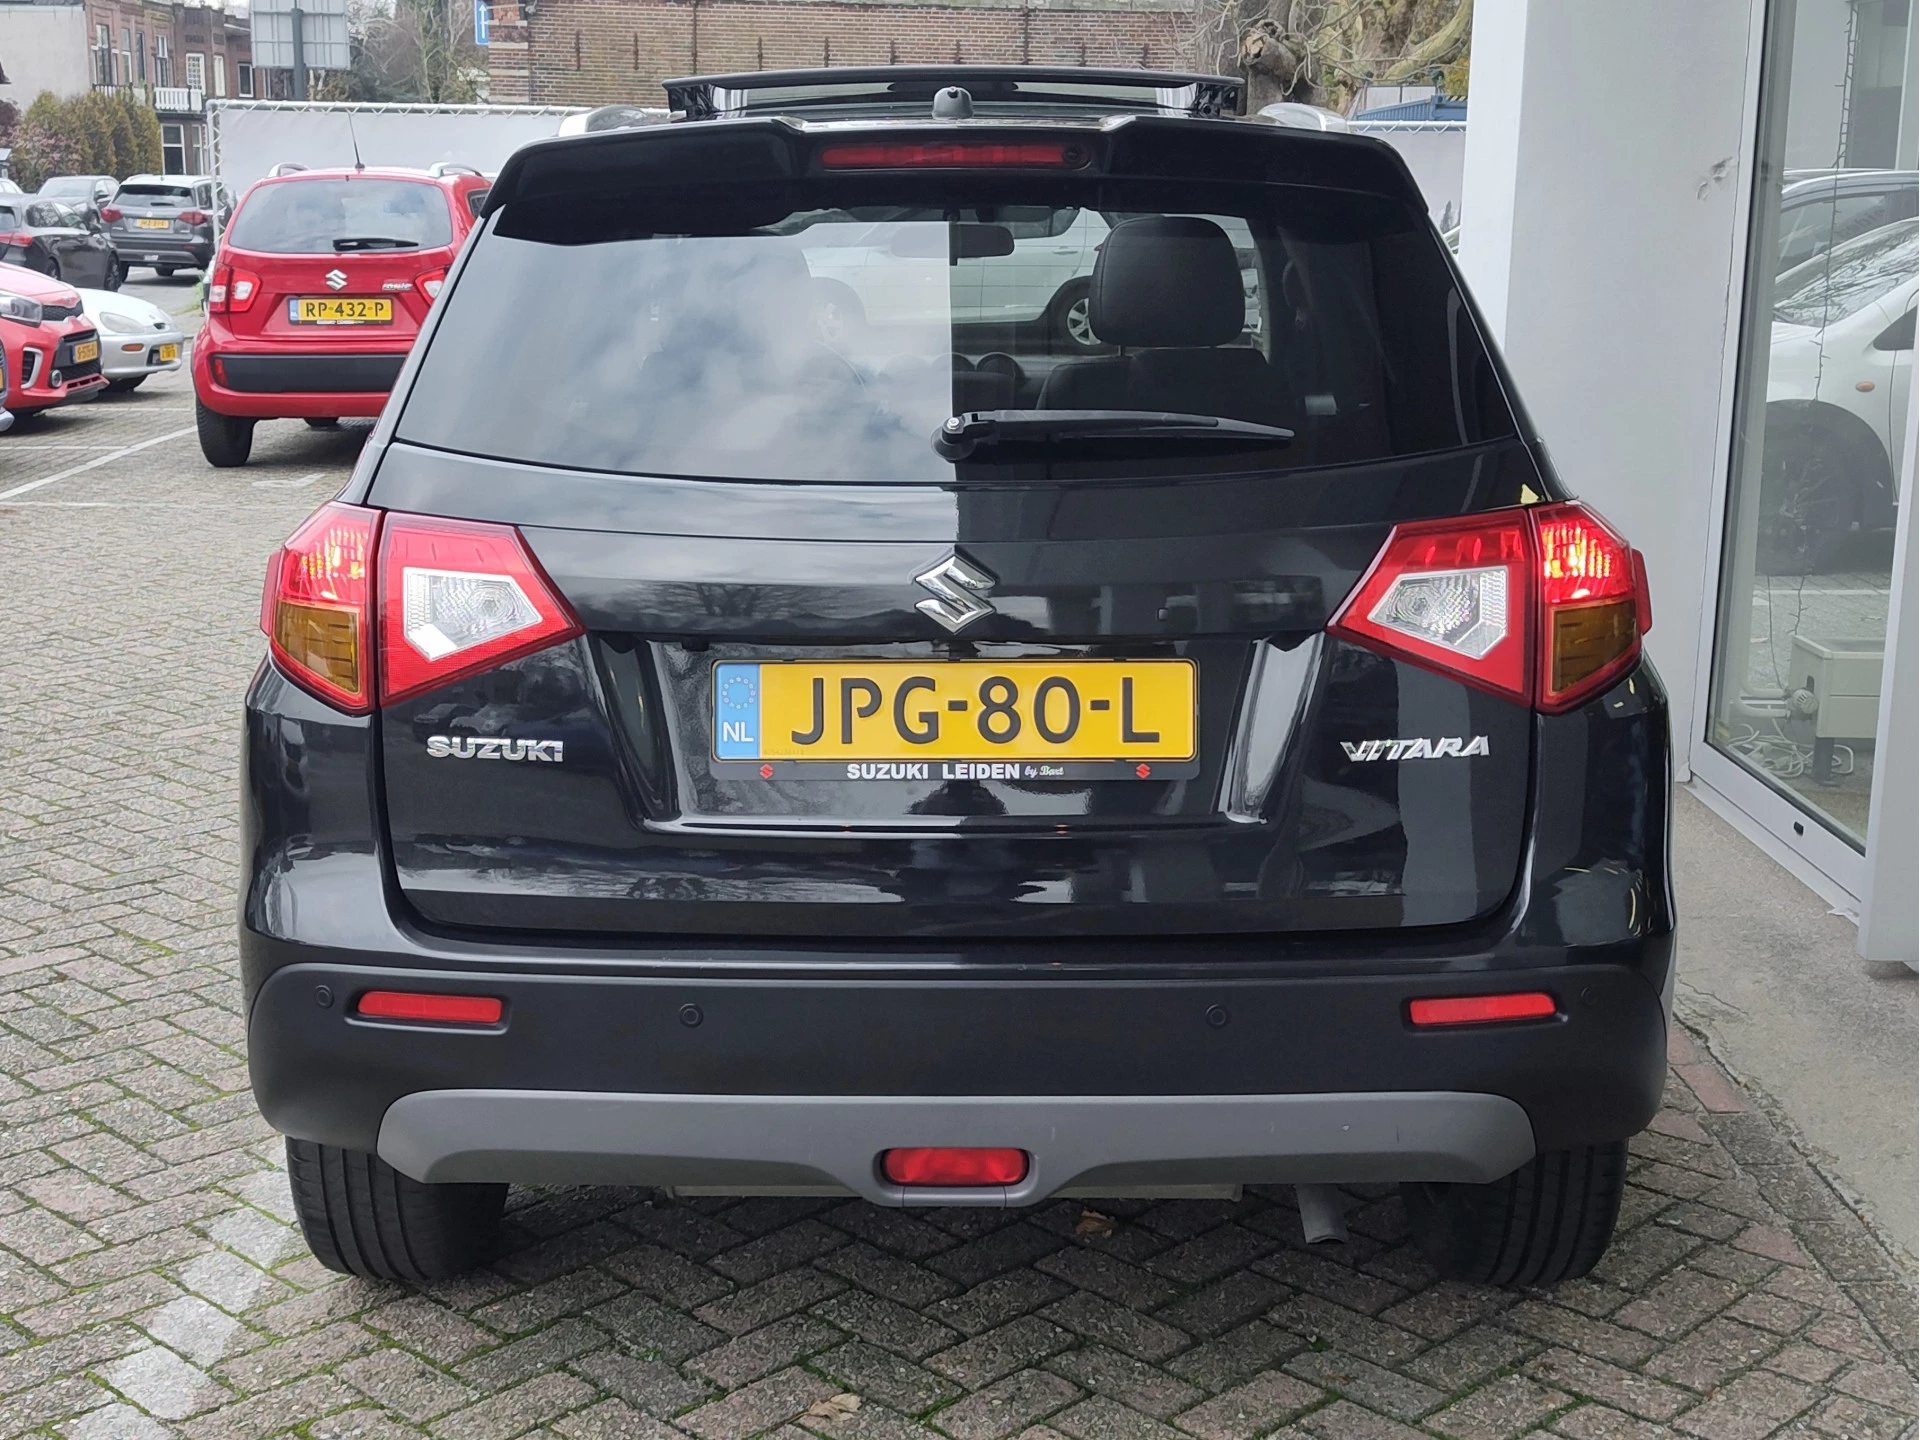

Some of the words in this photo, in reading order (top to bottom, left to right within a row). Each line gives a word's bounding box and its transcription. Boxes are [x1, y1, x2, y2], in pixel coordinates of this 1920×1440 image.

[305, 302, 384, 317] RP-432-P
[791, 676, 1160, 744] JPG-80-L
[722, 721, 754, 742] NL
[426, 735, 564, 762] SUZUKI
[1340, 735, 1490, 762] VITARA
[847, 763, 929, 780] SUZUKI
[942, 763, 1020, 780] LEIDEN
[1025, 765, 1038, 779] by
